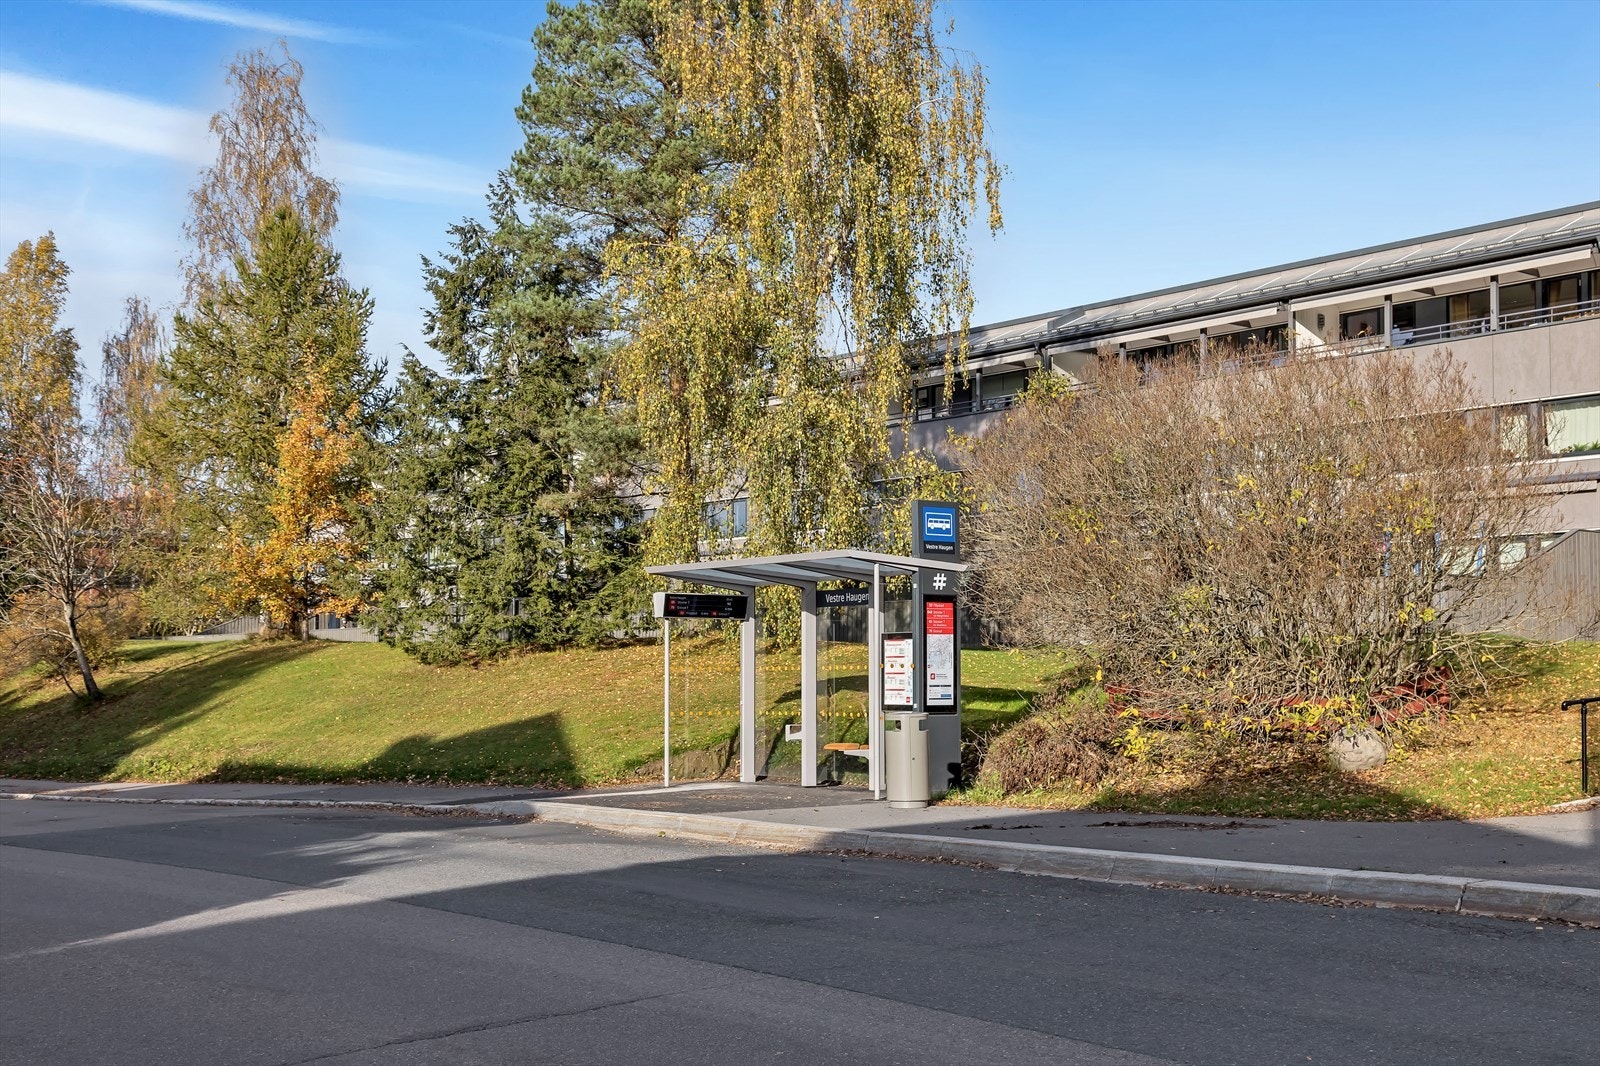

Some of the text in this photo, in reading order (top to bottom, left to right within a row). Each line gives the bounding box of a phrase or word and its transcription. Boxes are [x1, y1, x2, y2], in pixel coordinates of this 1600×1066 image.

[939, 544, 954, 552] Haugen
[825, 592, 870, 604] Vestre Haugen
